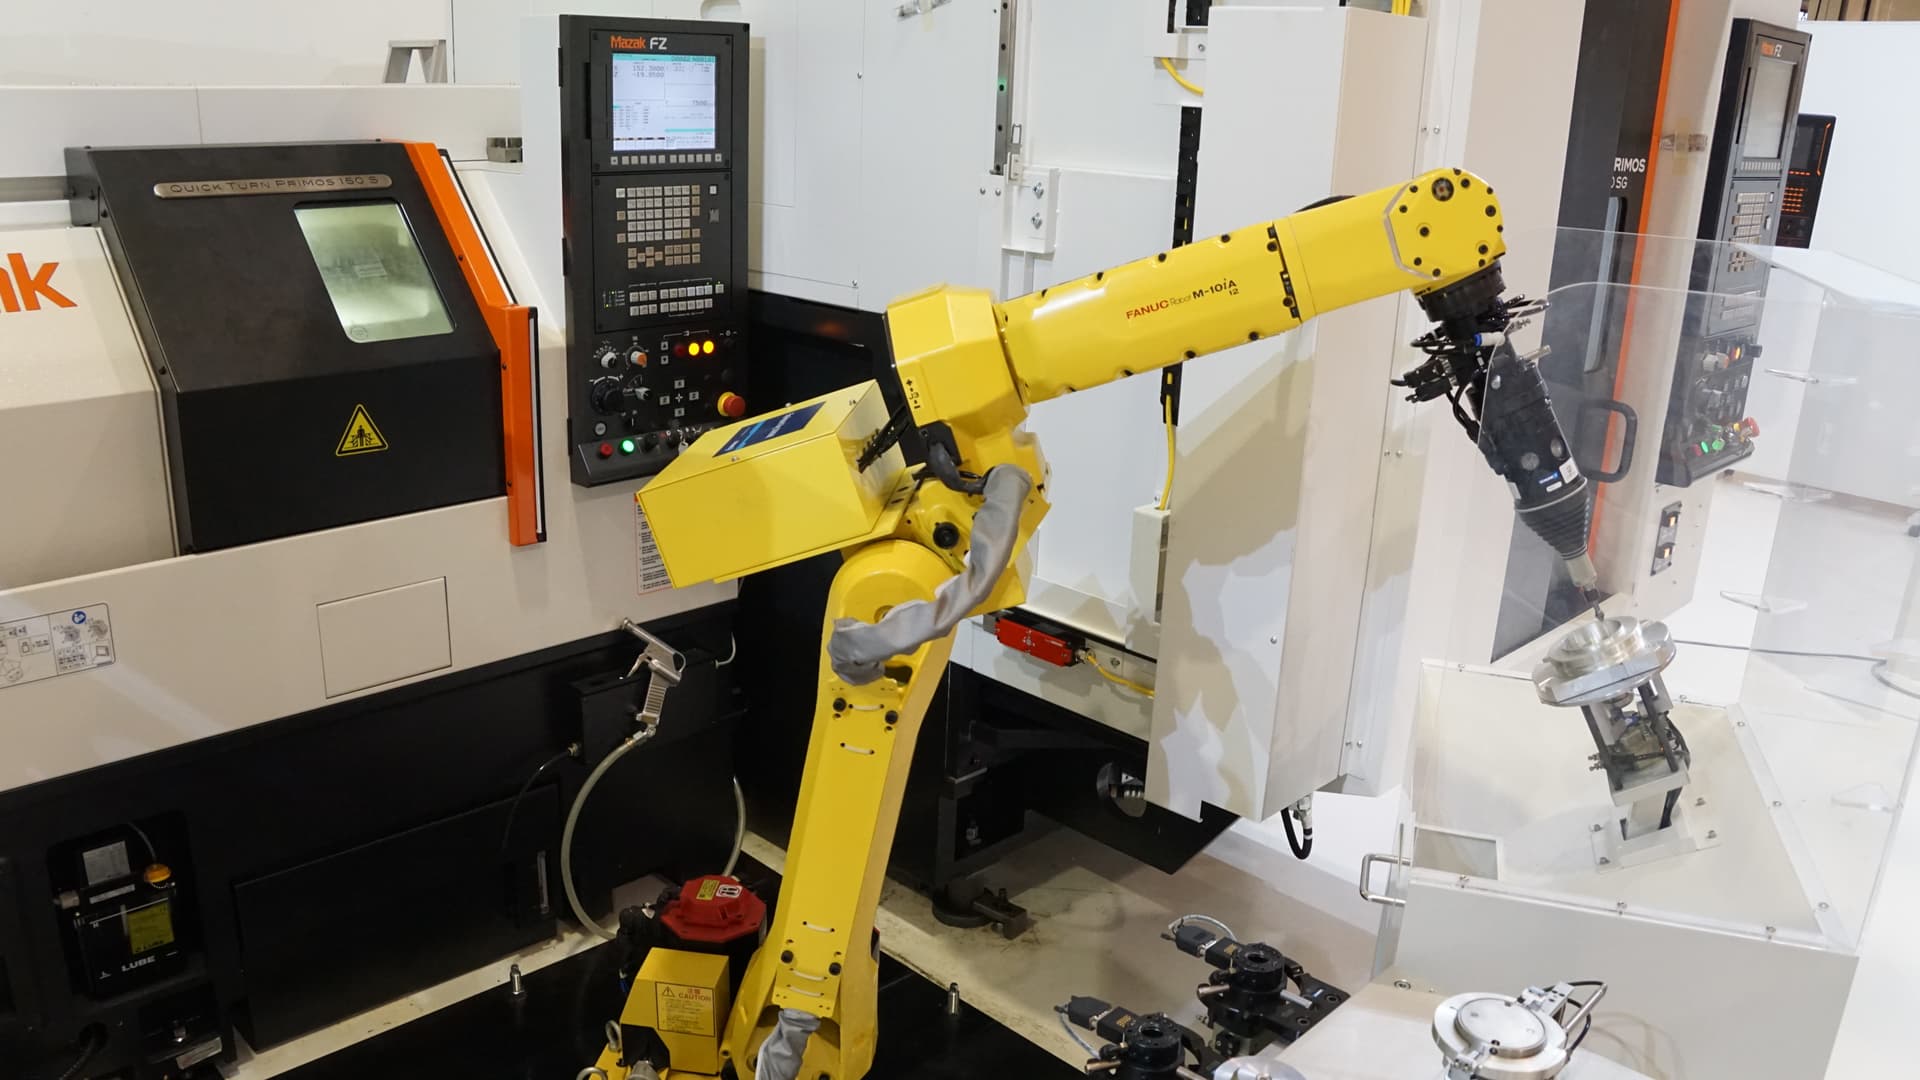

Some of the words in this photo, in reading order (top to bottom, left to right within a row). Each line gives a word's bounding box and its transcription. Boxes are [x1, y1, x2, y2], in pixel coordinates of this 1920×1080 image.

[610, 36, 646, 49] Mazak
[649, 37, 668, 50] FZ
[170, 183, 222, 193] QUICK
[228, 181, 270, 191] TURN
[275, 177, 335, 189] PRIMOS
[339, 175, 364, 185] 150
[368, 175, 379, 184] S
[1616, 176, 1628, 189] SG
[1125, 299, 1170, 320] FANUC
[1192, 278, 1237, 300] M-10iA
[1229, 288, 1240, 296] 12
[121, 955, 156, 972] LUBE
